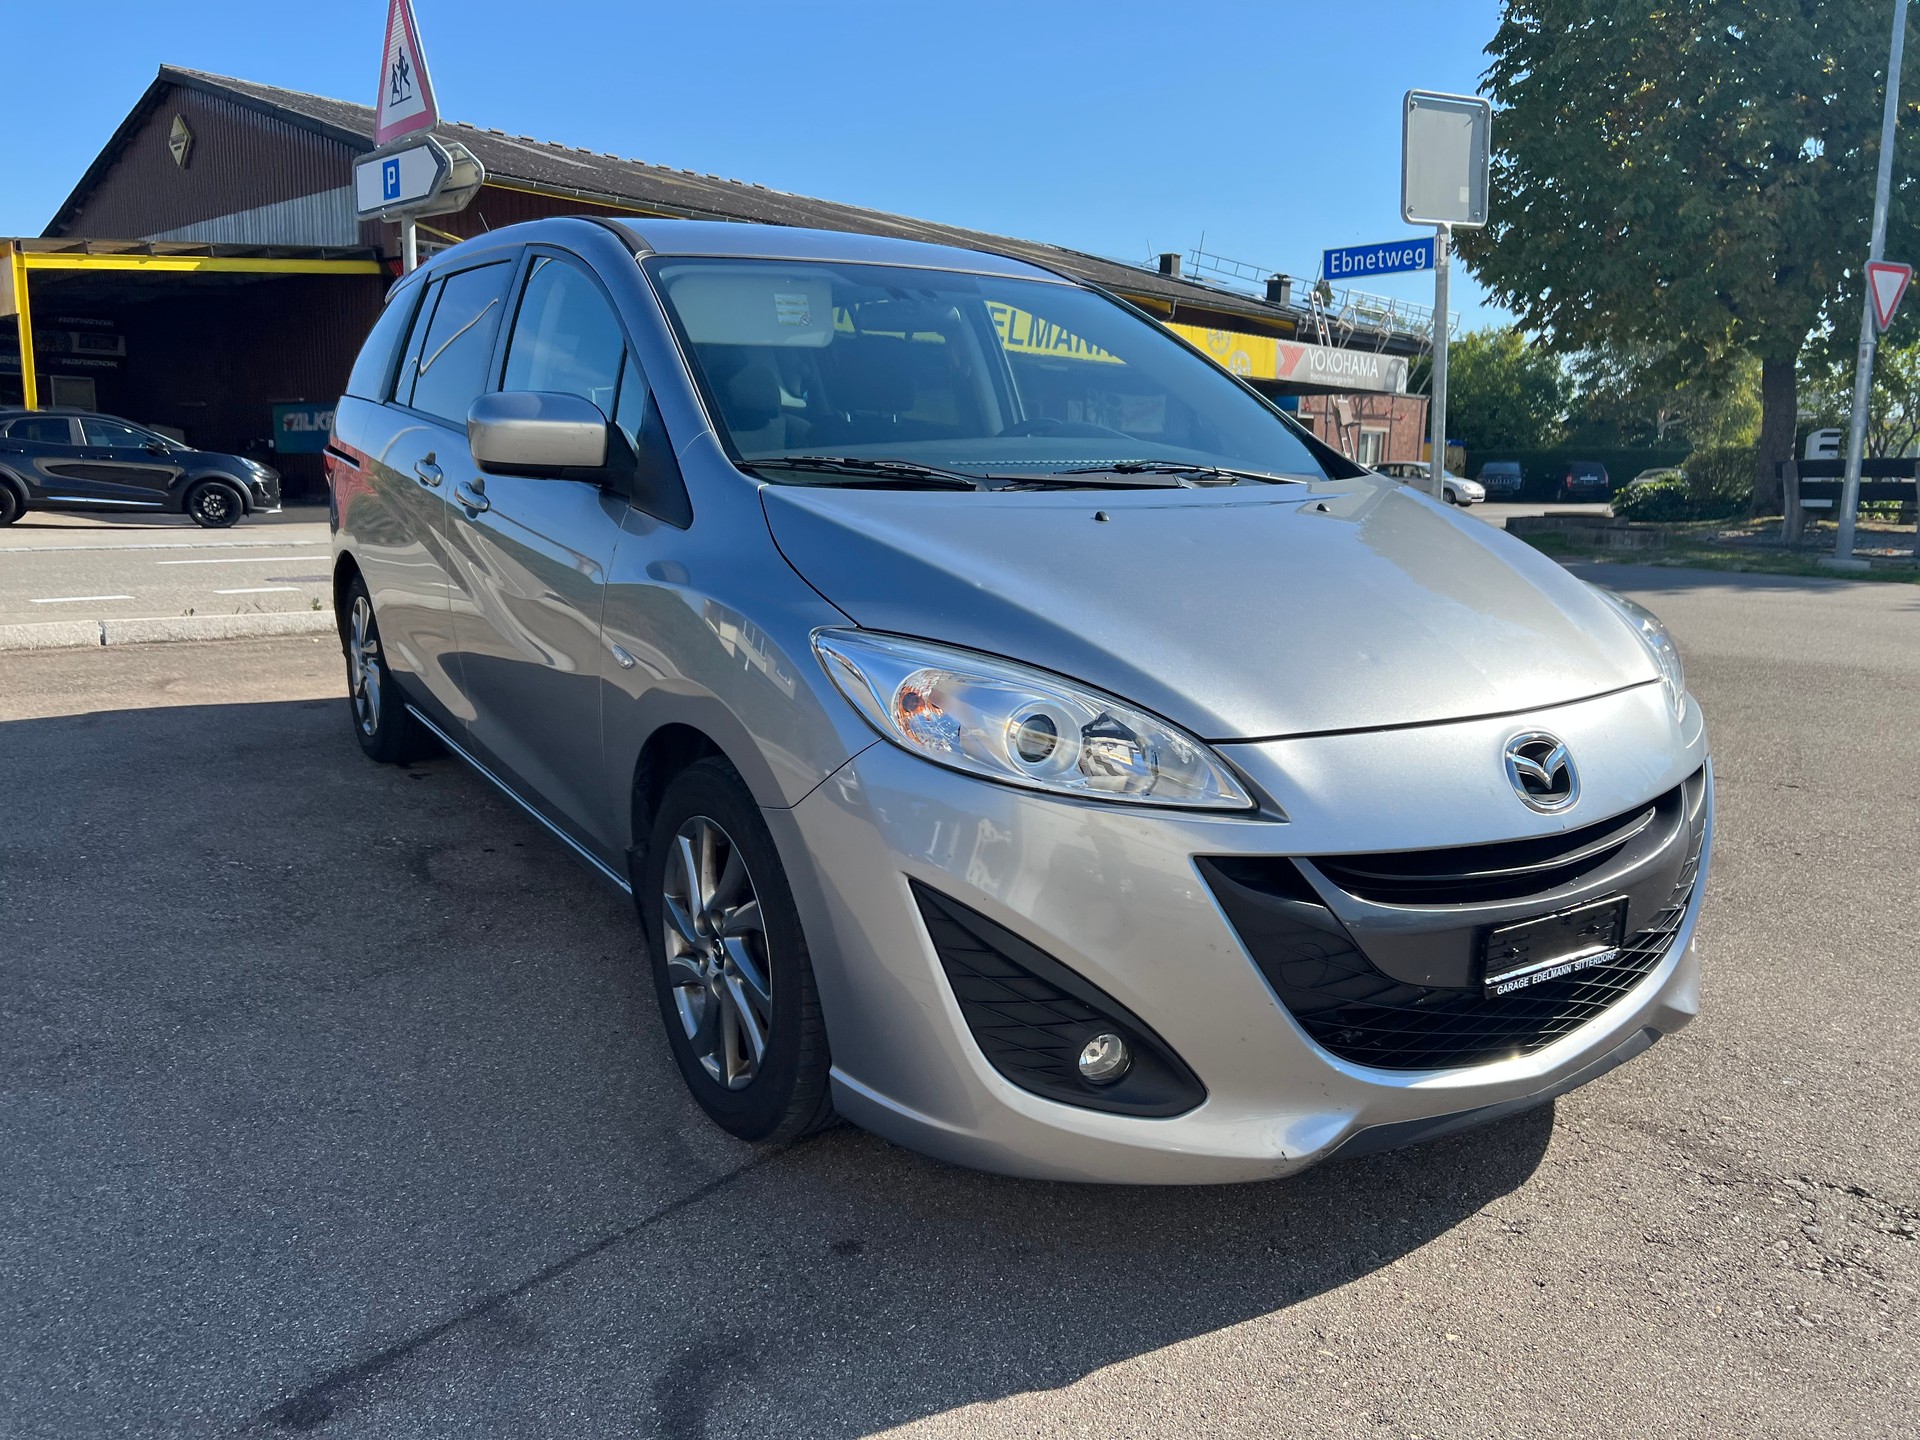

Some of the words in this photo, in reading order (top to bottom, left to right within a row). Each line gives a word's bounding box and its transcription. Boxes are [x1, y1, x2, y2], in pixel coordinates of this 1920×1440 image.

[387, 166, 396, 194] P
[1330, 246, 1427, 274] Ebnetweg
[1308, 348, 1379, 378] YOKOHAMA
[1496, 976, 1529, 996] GARAGE
[1532, 964, 1572, 985] EDELMANN
[1574, 951, 1617, 972] SITTERDORF
